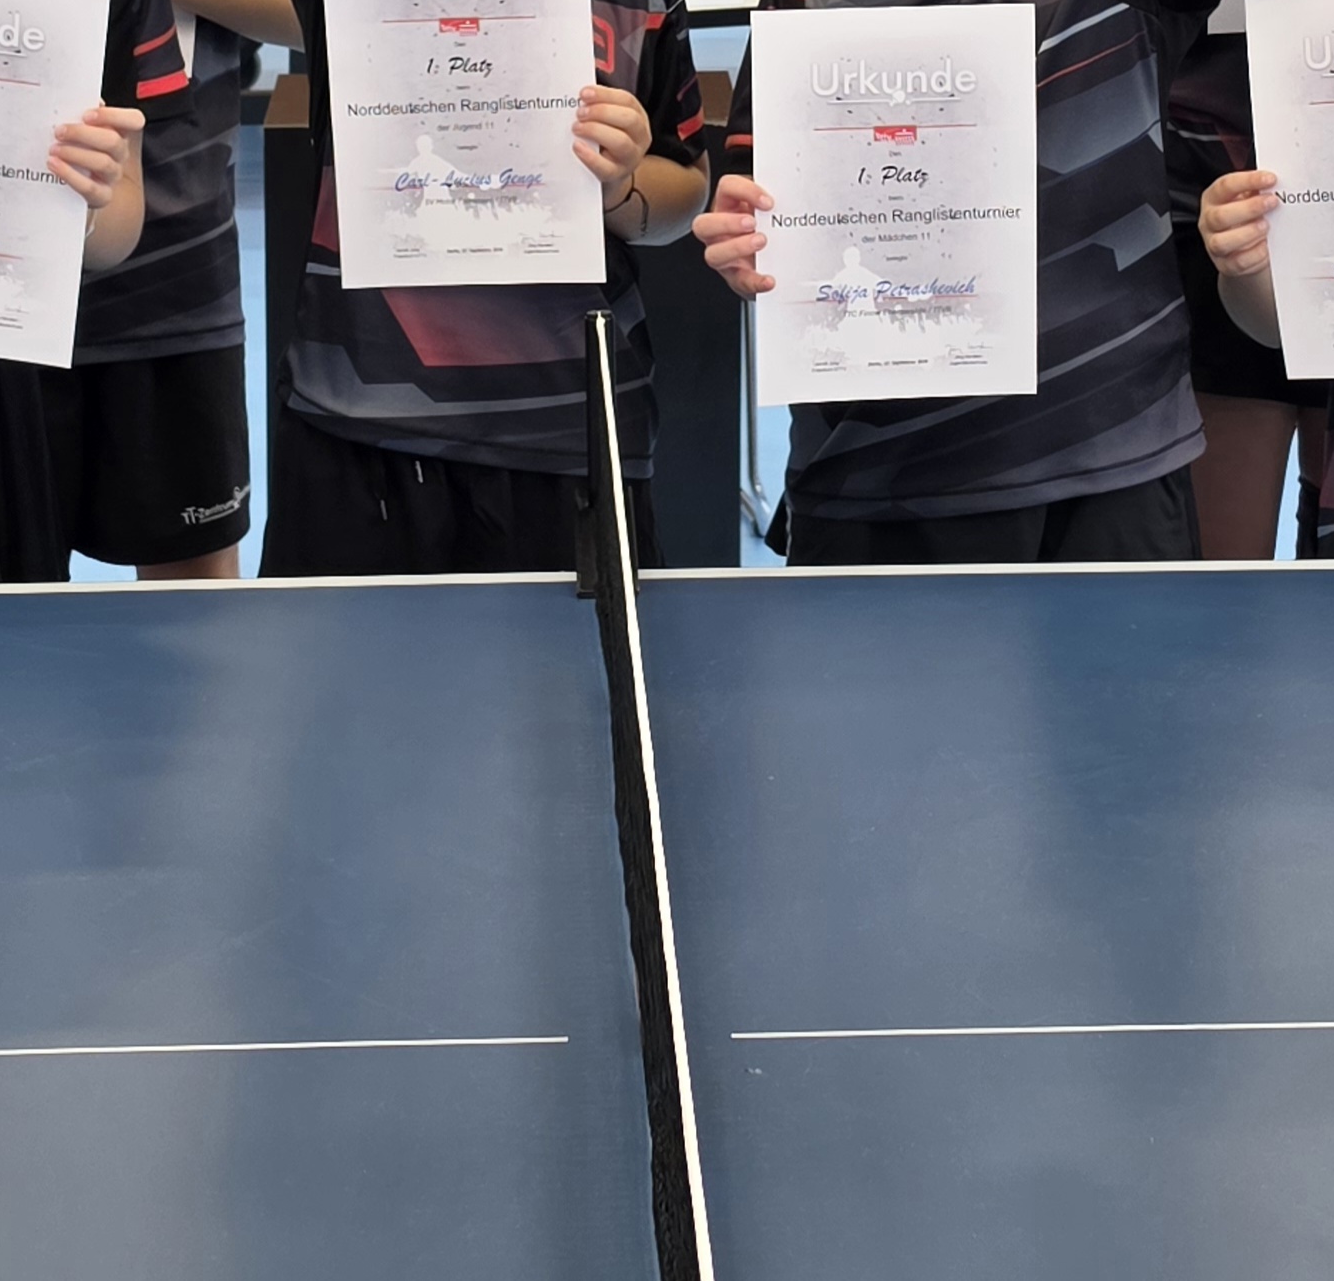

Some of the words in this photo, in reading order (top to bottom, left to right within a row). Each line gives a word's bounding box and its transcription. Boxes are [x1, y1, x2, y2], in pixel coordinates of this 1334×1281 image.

[448, 58, 493, 78] Platz
[811, 59, 978, 97] Urkunde
[347, 99, 456, 117] Norddeutschen
[460, 94, 582, 113] Ranglistenturnier
[881, 166, 929, 189] Platz
[771, 211, 887, 229] Norddeutschen
[892, 206, 1022, 224] Ranglistenturnier
